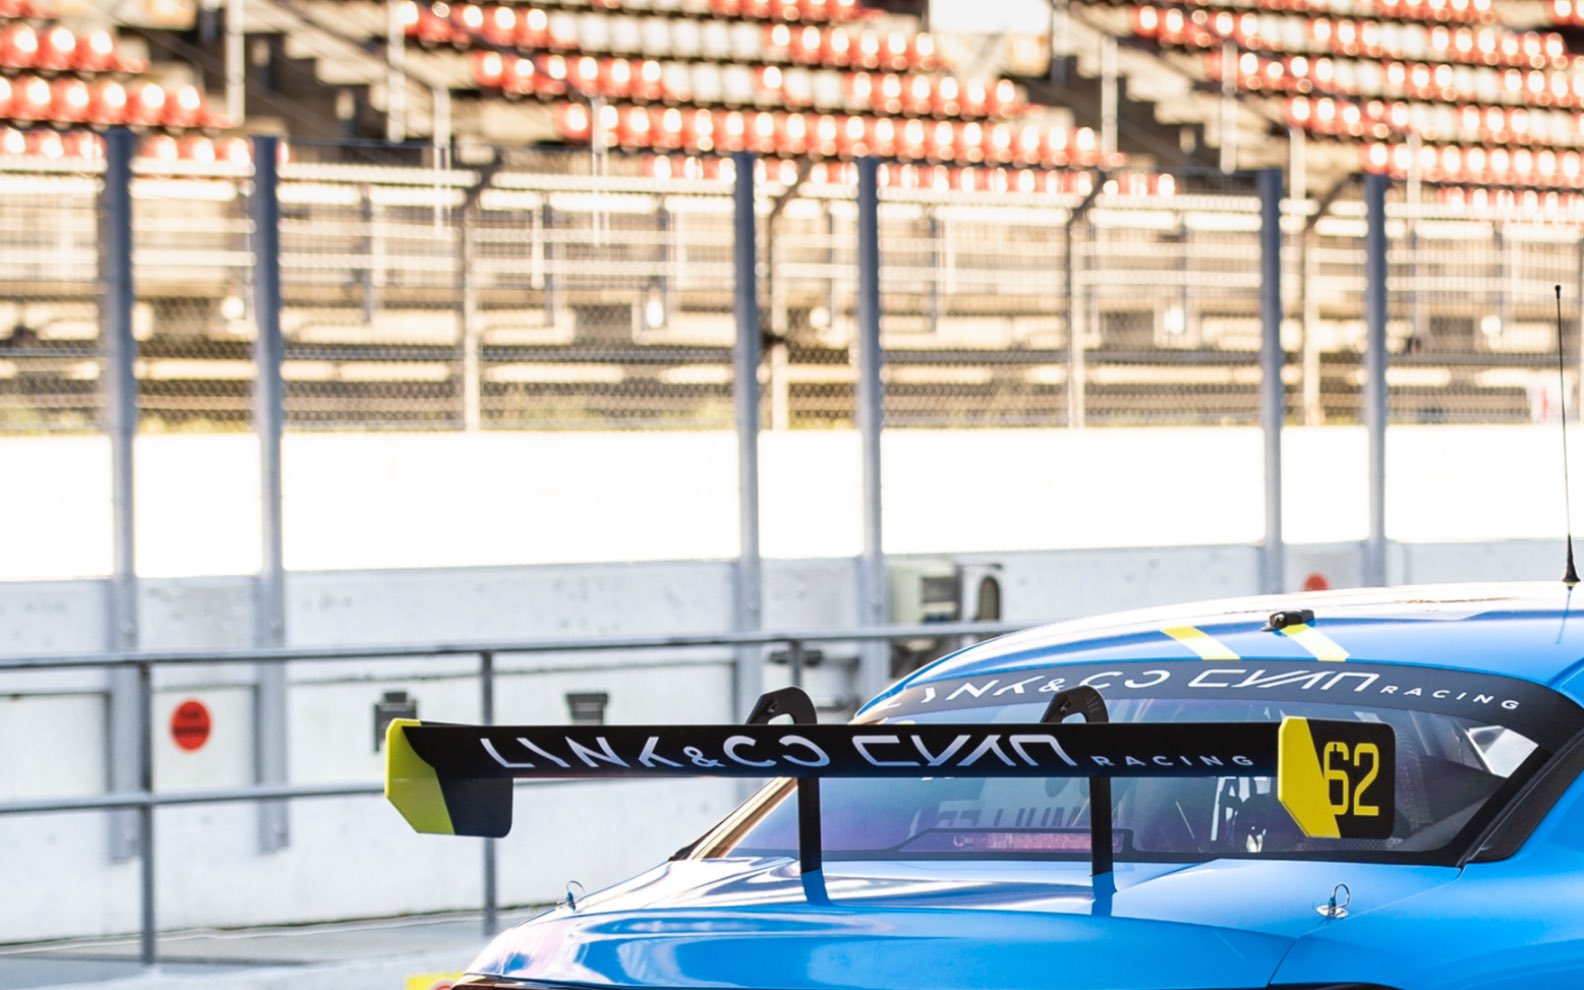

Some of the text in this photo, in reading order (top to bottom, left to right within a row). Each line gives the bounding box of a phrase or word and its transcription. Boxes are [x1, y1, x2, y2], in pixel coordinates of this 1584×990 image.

[1380, 684, 1522, 711] RACING
[1090, 755, 1256, 767] RACING
[1322, 741, 1380, 817] 62
